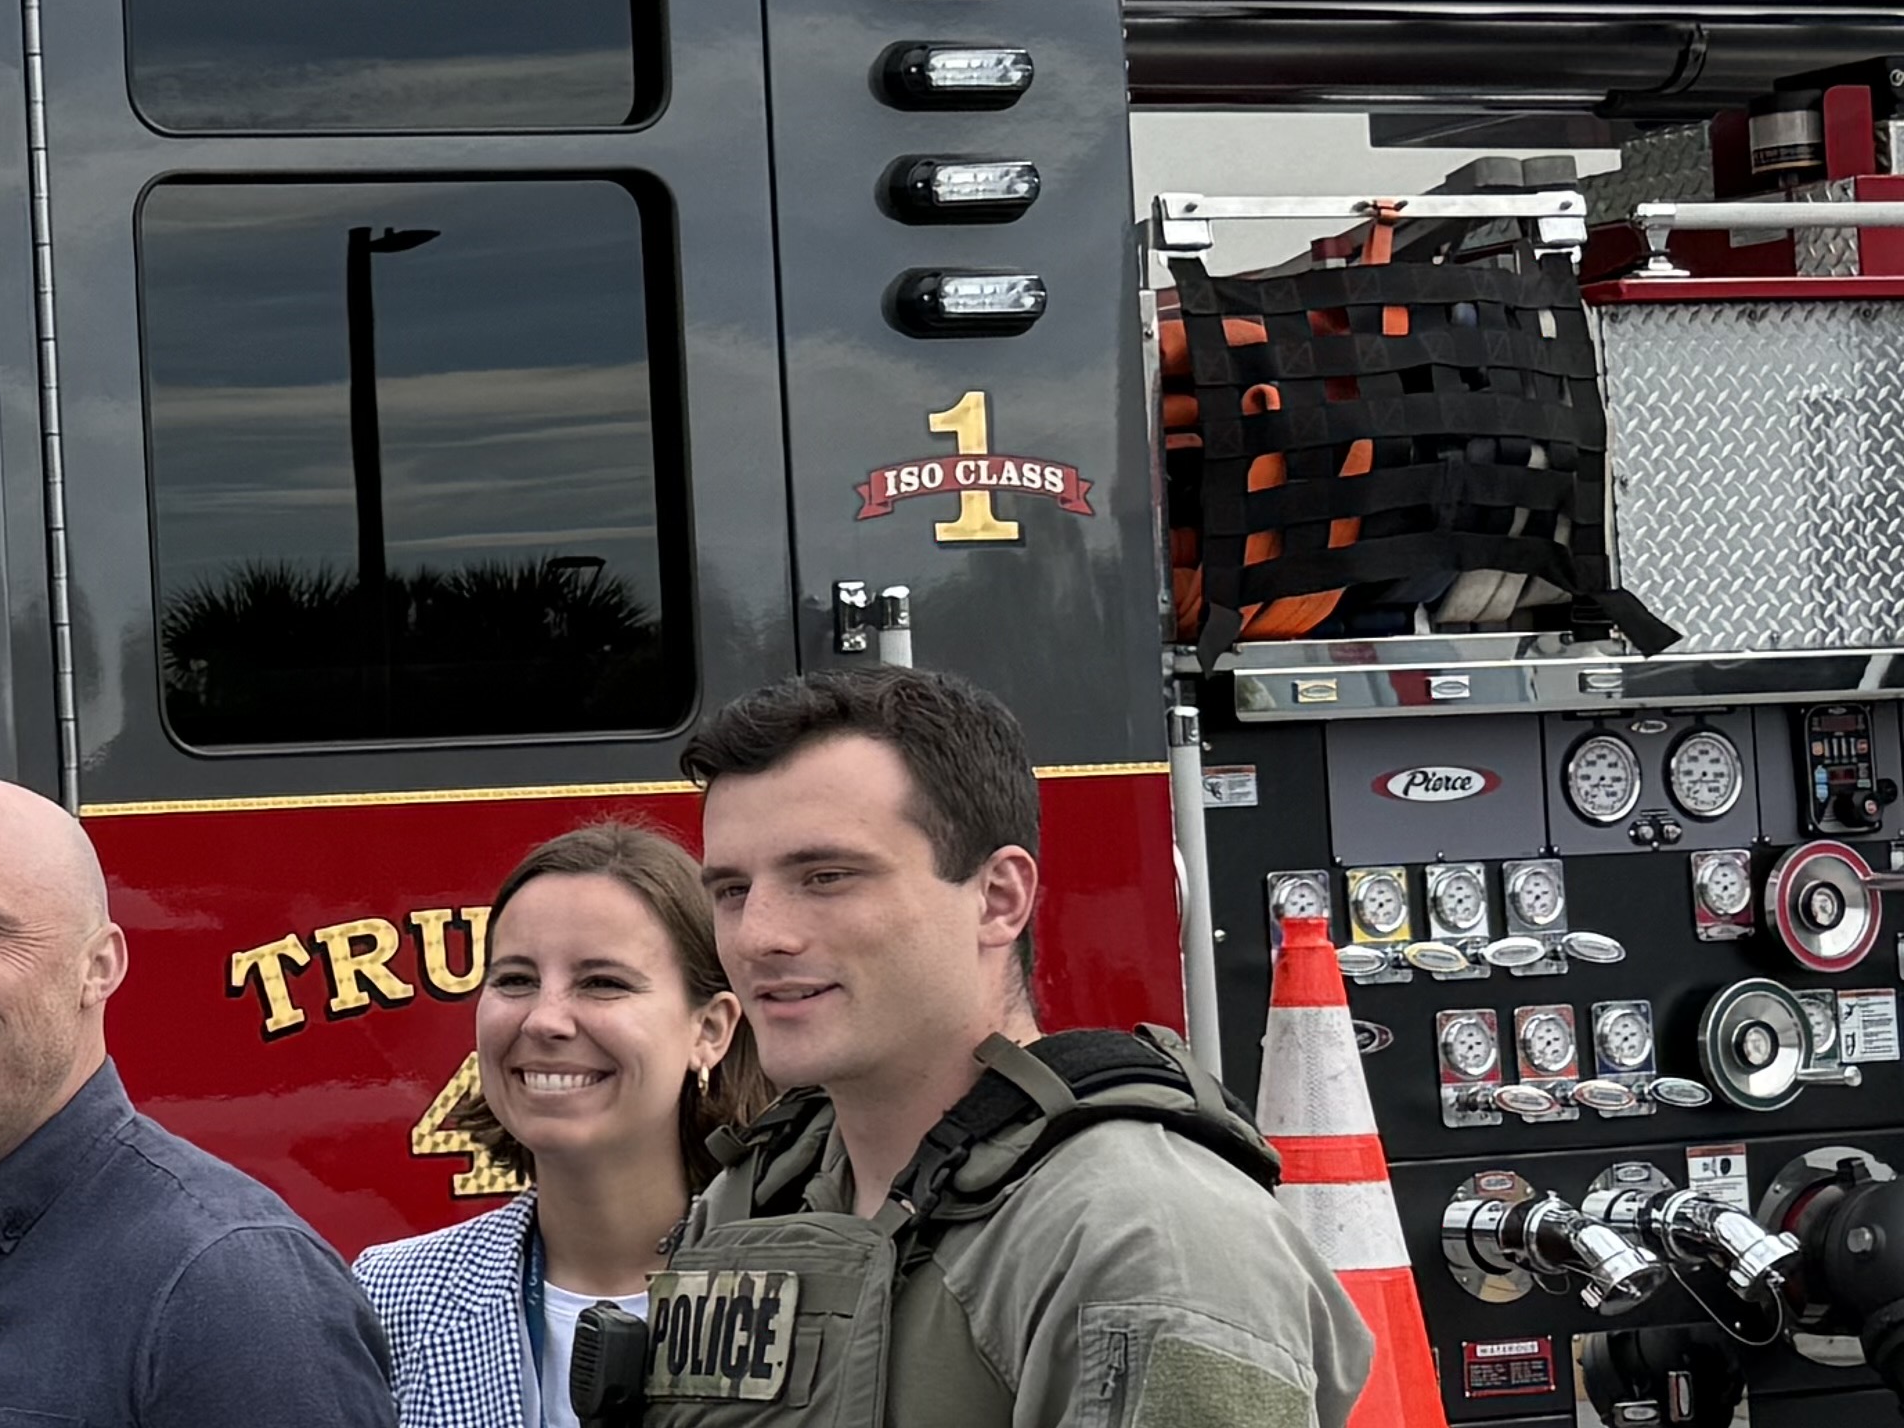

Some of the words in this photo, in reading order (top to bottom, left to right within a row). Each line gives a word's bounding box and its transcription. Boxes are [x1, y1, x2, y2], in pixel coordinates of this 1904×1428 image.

[884, 463, 944, 497] ISO
[955, 459, 1065, 493] CLASS
[928, 390, 1019, 542] 1
[231, 905, 493, 1033] TRU
[648, 1294, 781, 1380] POLICE
